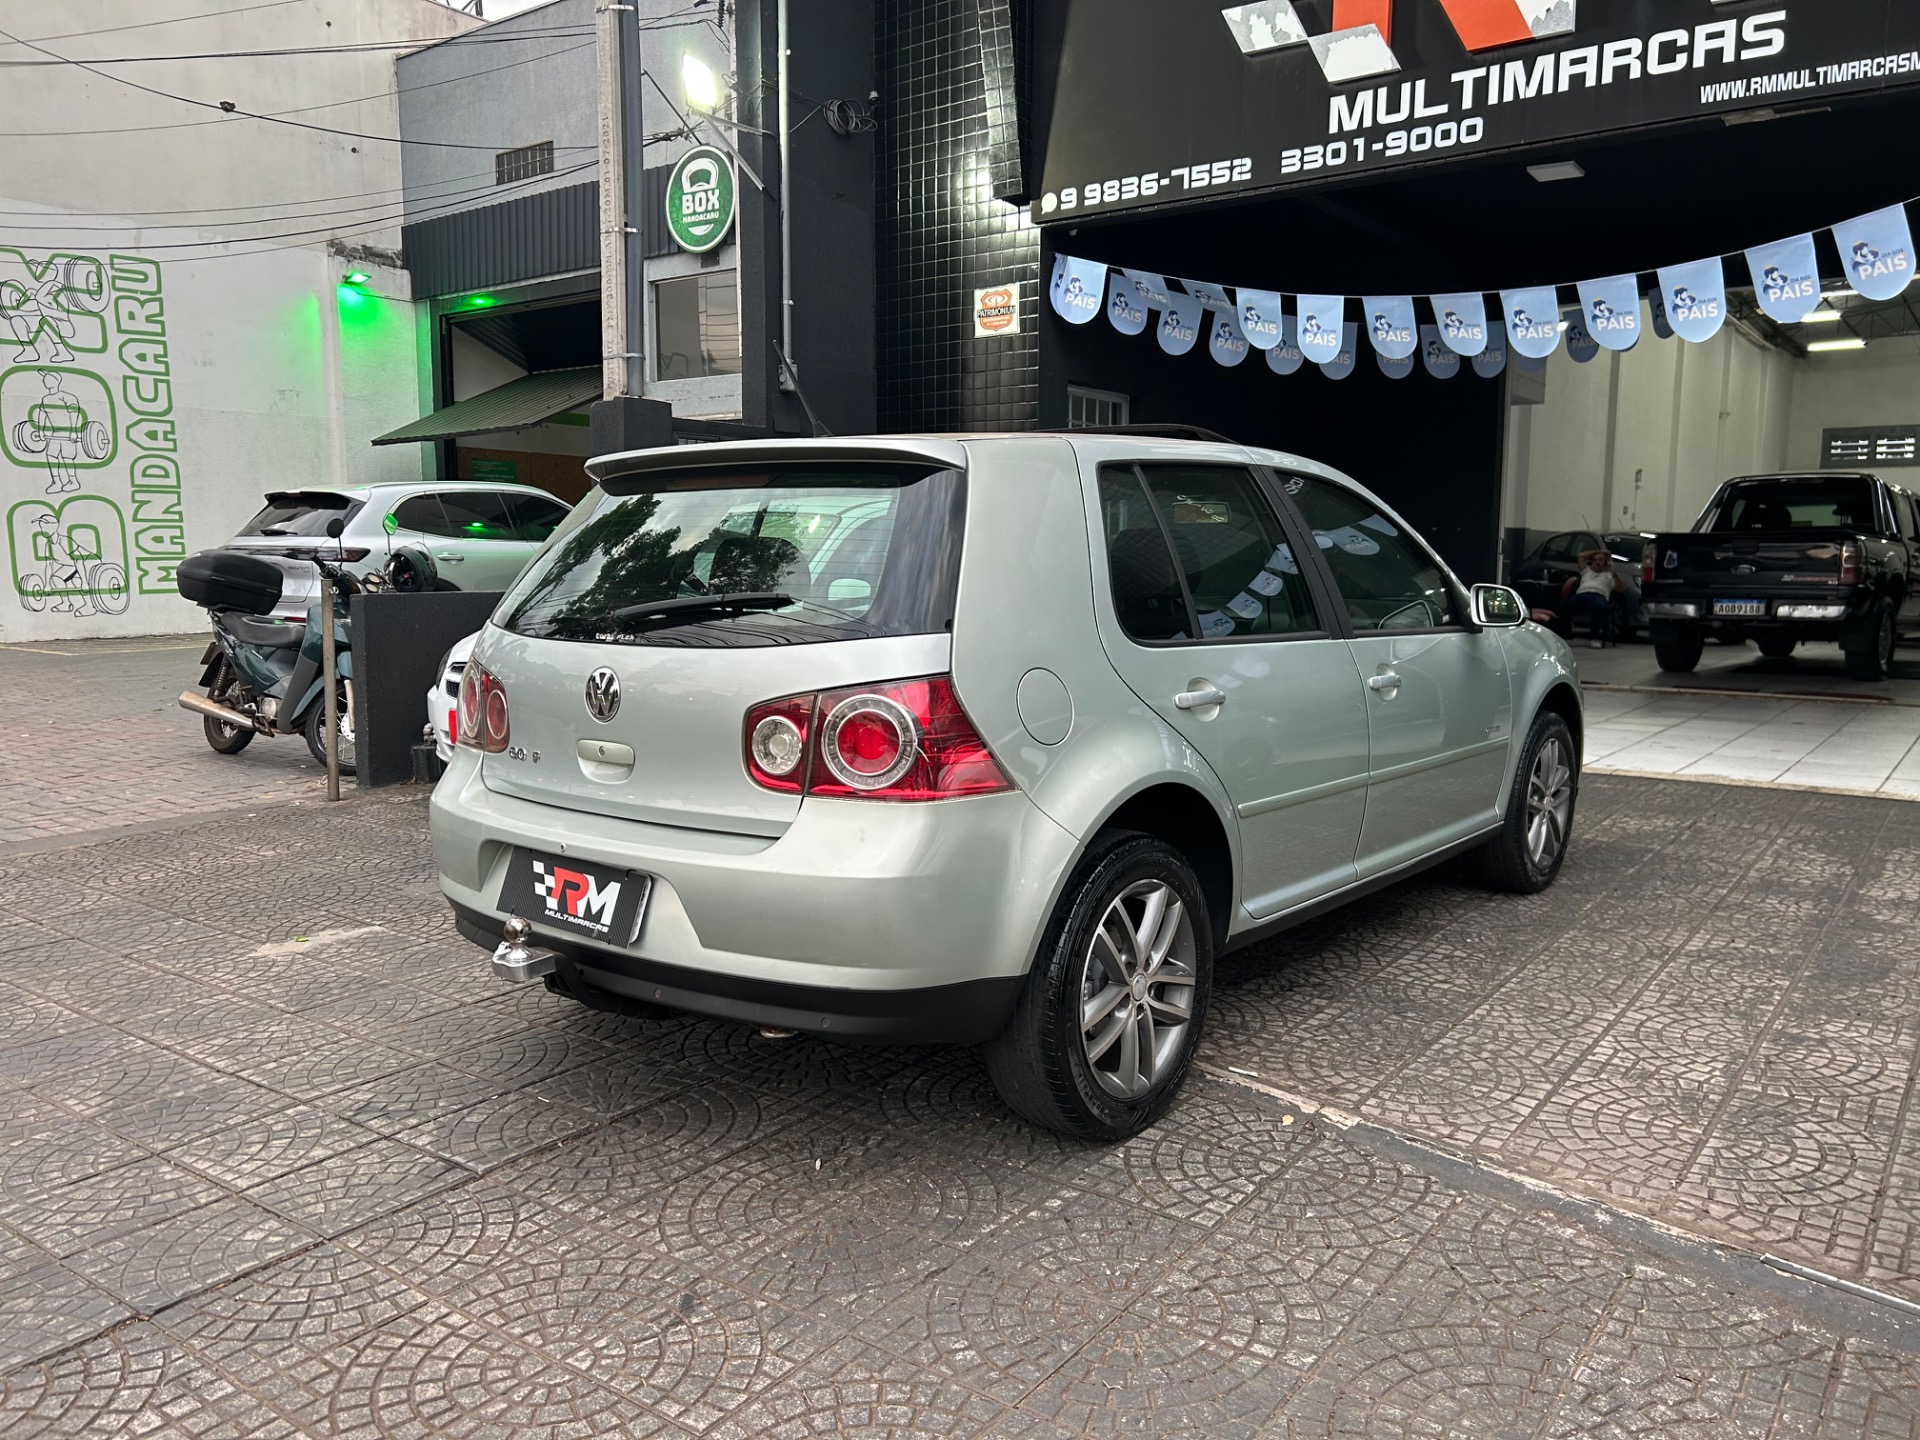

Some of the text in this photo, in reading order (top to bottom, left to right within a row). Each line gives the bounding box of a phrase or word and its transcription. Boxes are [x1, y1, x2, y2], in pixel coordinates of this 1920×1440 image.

[1328, 9, 1787, 134] MULTIMARCAS
[1060, 117, 1484, 210] 9 9836-7552 3301-9000
[682, 189, 719, 215] BOX
[682, 211, 720, 224] MANDACARU
[1858, 253, 1908, 280] PAIS
[1768, 280, 1814, 303] PAIS
[1065, 293, 1096, 310] PAIS
[1114, 306, 1142, 322] PAIS
[1677, 302, 1719, 322] PAIS
[1247, 321, 1277, 335] PAIS
[1597, 316, 1635, 331] PAIS
[1165, 326, 1193, 341] PAIS
[1377, 331, 1411, 342] PAIS
[1449, 327, 1482, 340] PAIS
[1517, 325, 1554, 339] PAIS
[1217, 338, 1244, 352] PAIS
[1305, 333, 1336, 347] PAIS
[1272, 347, 1299, 360] PAIS
[1331, 354, 1351, 364] AIS
[1430, 354, 1455, 364] PAIS
[0, 246, 129, 597] BOX
[109, 253, 187, 595] MANDACARU
[544, 908, 610, 933] MULTIMARCAS
